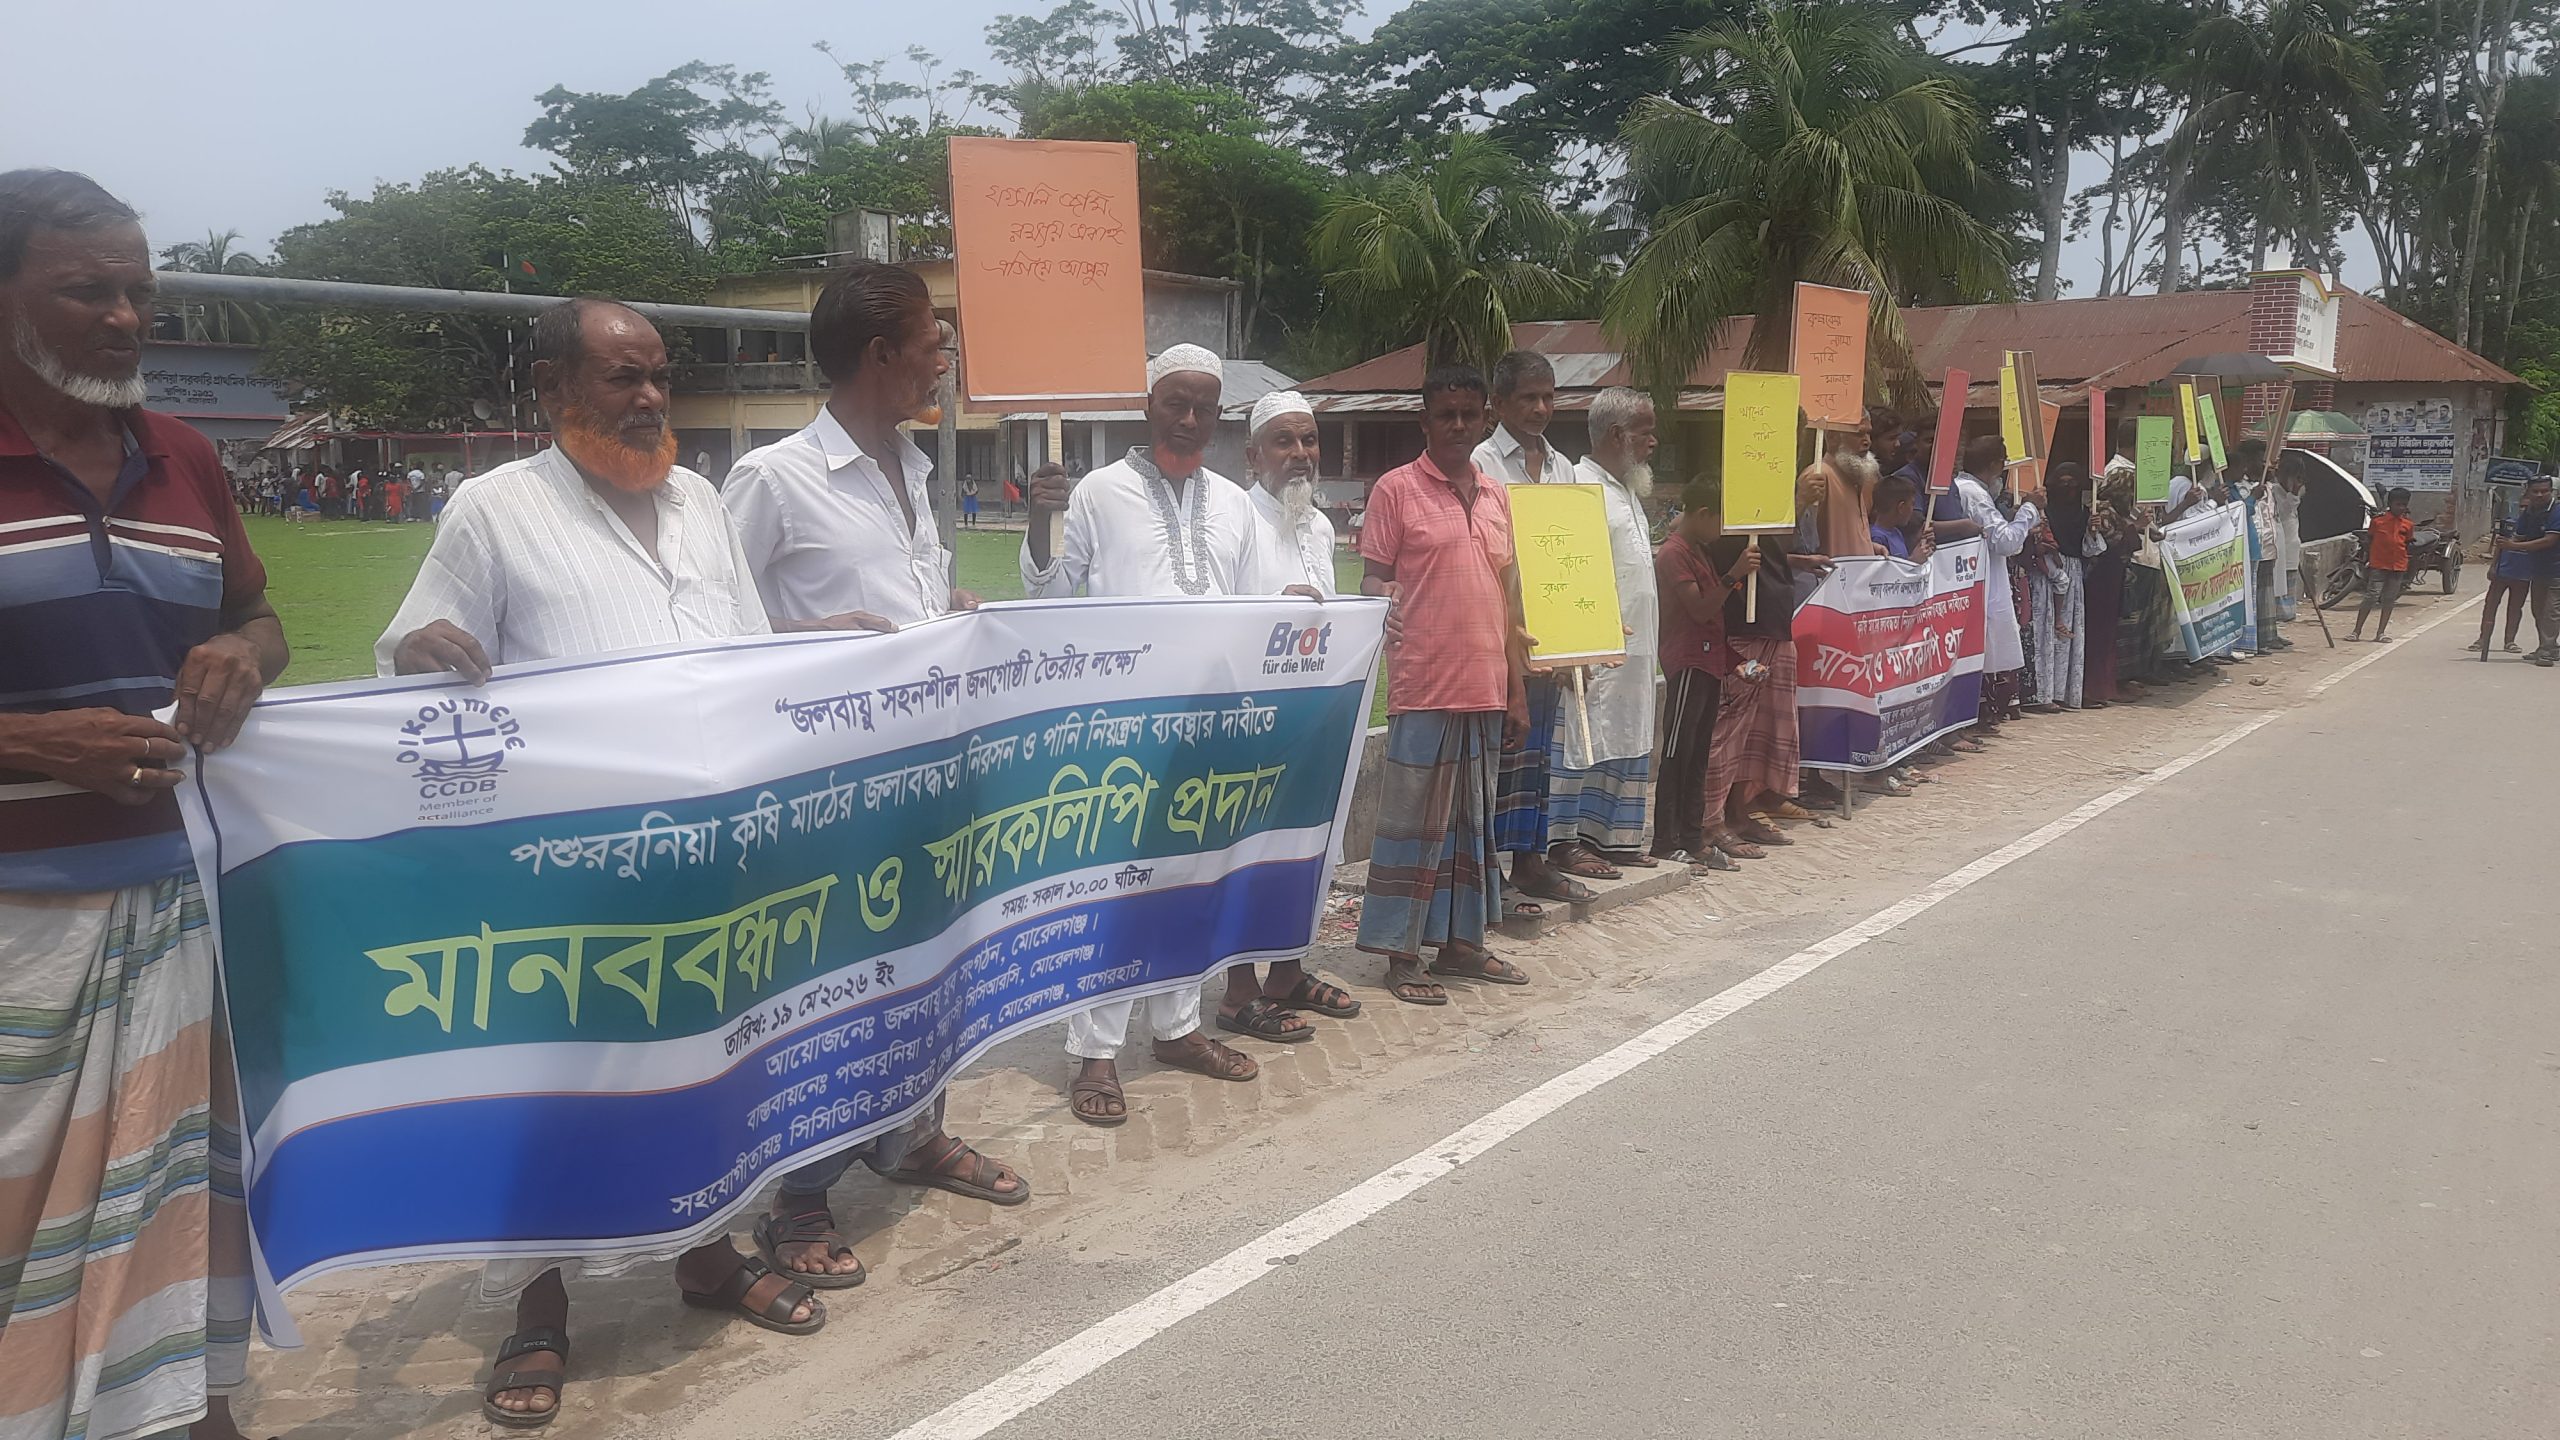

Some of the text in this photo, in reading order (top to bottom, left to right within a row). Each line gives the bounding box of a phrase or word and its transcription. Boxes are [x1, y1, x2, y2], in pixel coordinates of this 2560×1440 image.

[1058, 260, 1110, 291] আসুন
[1530, 525, 1574, 557] জমি
[1956, 555, 1978, 574] Bro
[1265, 622, 1332, 656] Brot
[877, 665, 960, 718] সহনশীল
[966, 648, 1033, 698] জনগোষ্ঠী
[1035, 643, 1088, 684] তৈরীর
[1262, 657, 1325, 674] für die Welt
[419, 779, 497, 799] CCDB
[419, 794, 498, 811] Member of
[510, 696, 1278, 882] পশুরবুনিয়া কৃষি মাঠের জলাবদ্ধতা নিরসন ও পানি নিয়ন্ত্রণ ব্যবস্থার দাবীতে
[417, 807, 494, 821] actalliance
[363, 756, 1287, 1034] মানববন্ধন ও স্মারকলিপি প্রদান
[1032, 881, 1064, 906] সকাল
[1065, 876, 1109, 901] ১০.০০
[1114, 864, 1155, 891] ঘটিকা
[771, 1004, 792, 1031] ১৯
[874, 960, 895, 991] ইং
[884, 988, 941, 1032] জলবায়ু
[835, 1036, 922, 1085] পশুরবুনিয়া
[925, 1030, 934, 1050] ও
